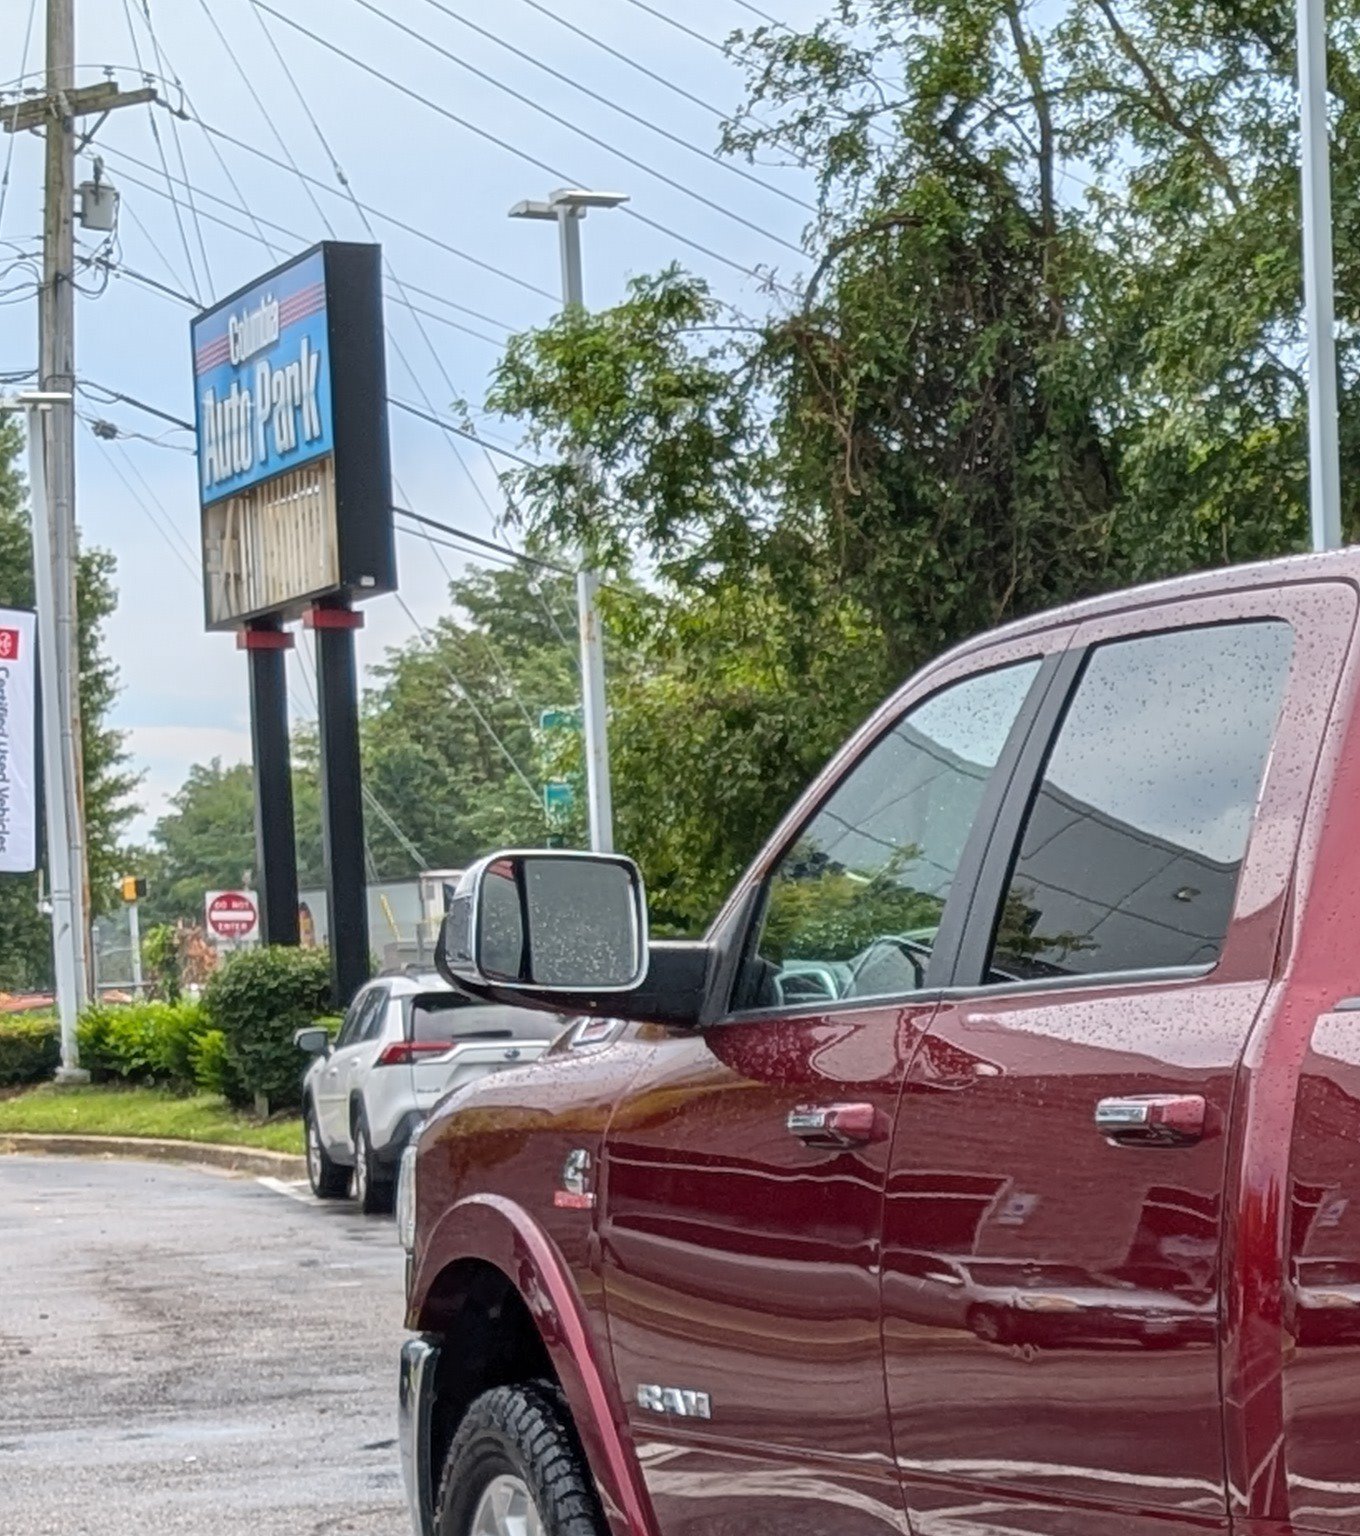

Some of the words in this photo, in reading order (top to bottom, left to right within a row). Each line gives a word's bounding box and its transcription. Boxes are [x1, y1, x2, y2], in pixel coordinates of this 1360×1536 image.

[202, 382, 252, 489] Auto
[256, 335, 324, 466] Park
[637, 1383, 711, 1420] RAM
